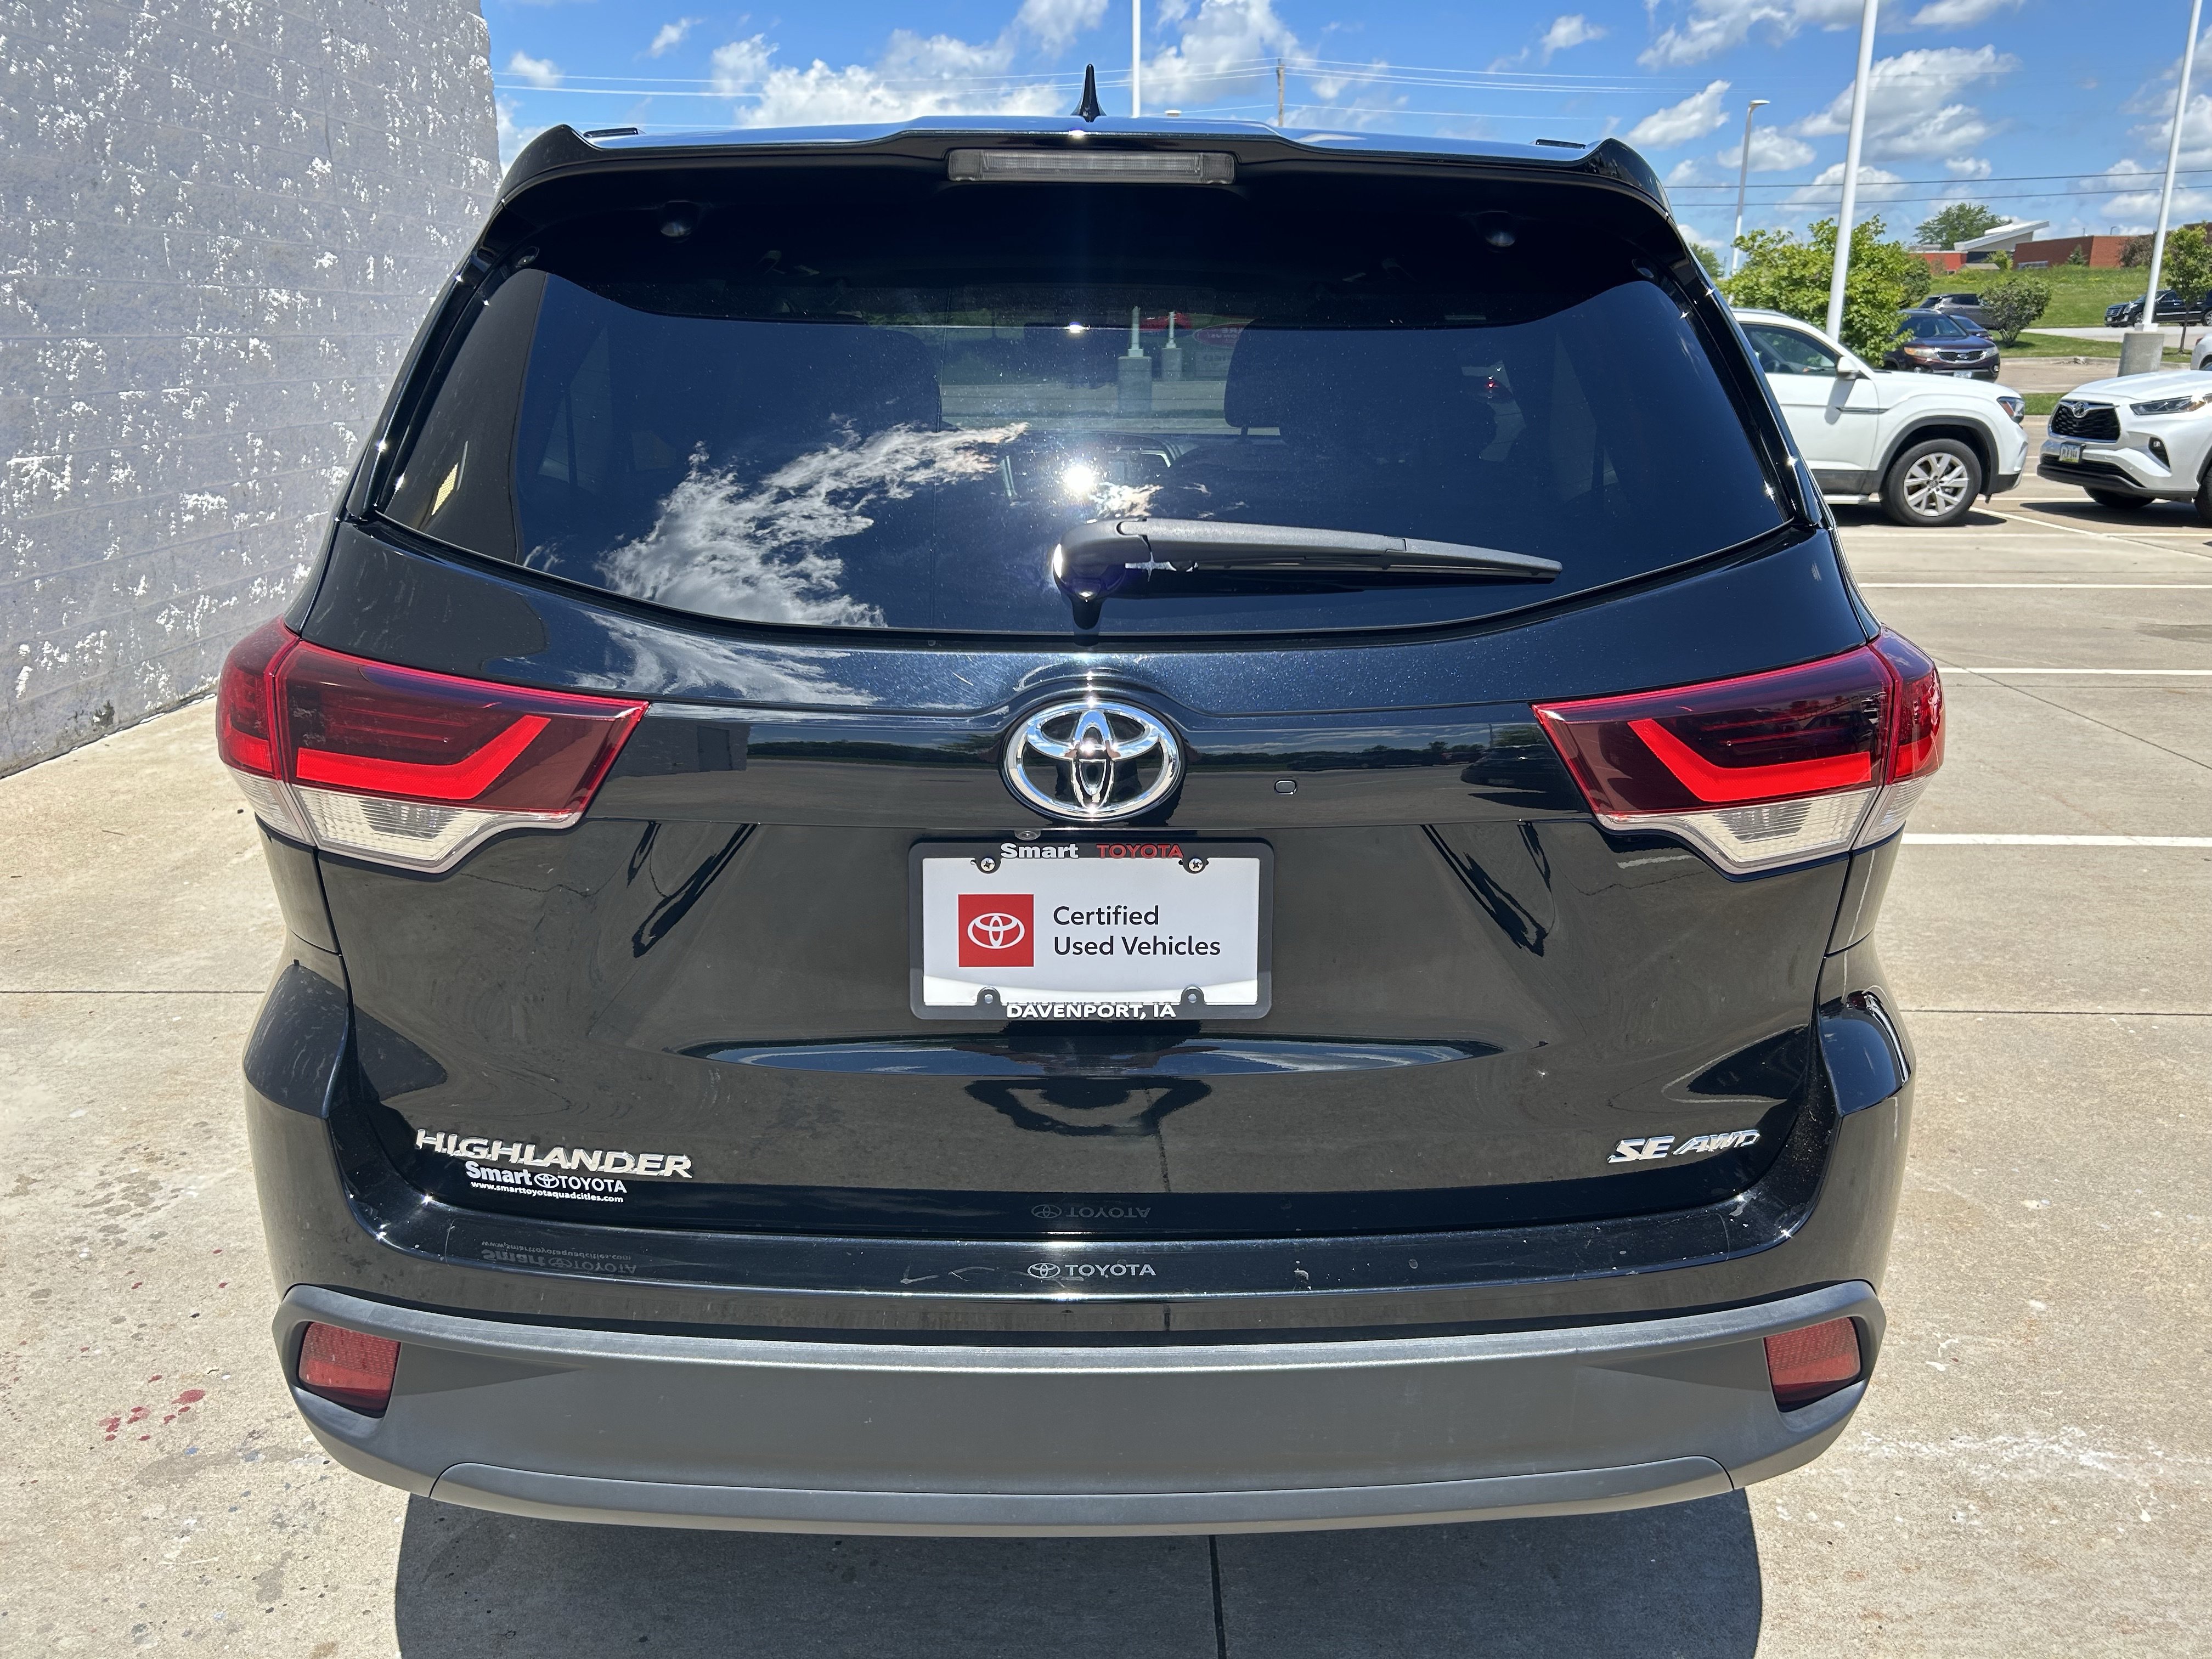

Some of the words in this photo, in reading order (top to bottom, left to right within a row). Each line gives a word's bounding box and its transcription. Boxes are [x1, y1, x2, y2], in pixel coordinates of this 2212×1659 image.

[1000, 843, 1079, 859] Smart
[1096, 844, 1183, 859] TOYOTA
[1053, 905, 1159, 926] Certified
[1054, 935, 1114, 956] Used
[1122, 935, 1221, 956] Vehicles
[1006, 1003, 1147, 1020] DAVENPORT,
[1153, 1003, 1176, 1018] IA
[416, 1129, 692, 1178] HIGHLANDER
[1607, 1135, 1675, 1164] SE
[1672, 1128, 1761, 1155] AWD
[465, 1160, 533, 1186] Smart
[557, 1175, 628, 1193] TOYOTA
[470, 1181, 624, 1203] www.smarttoyotaquadcities.com
[1065, 1264, 1156, 1276] TOYOTA
